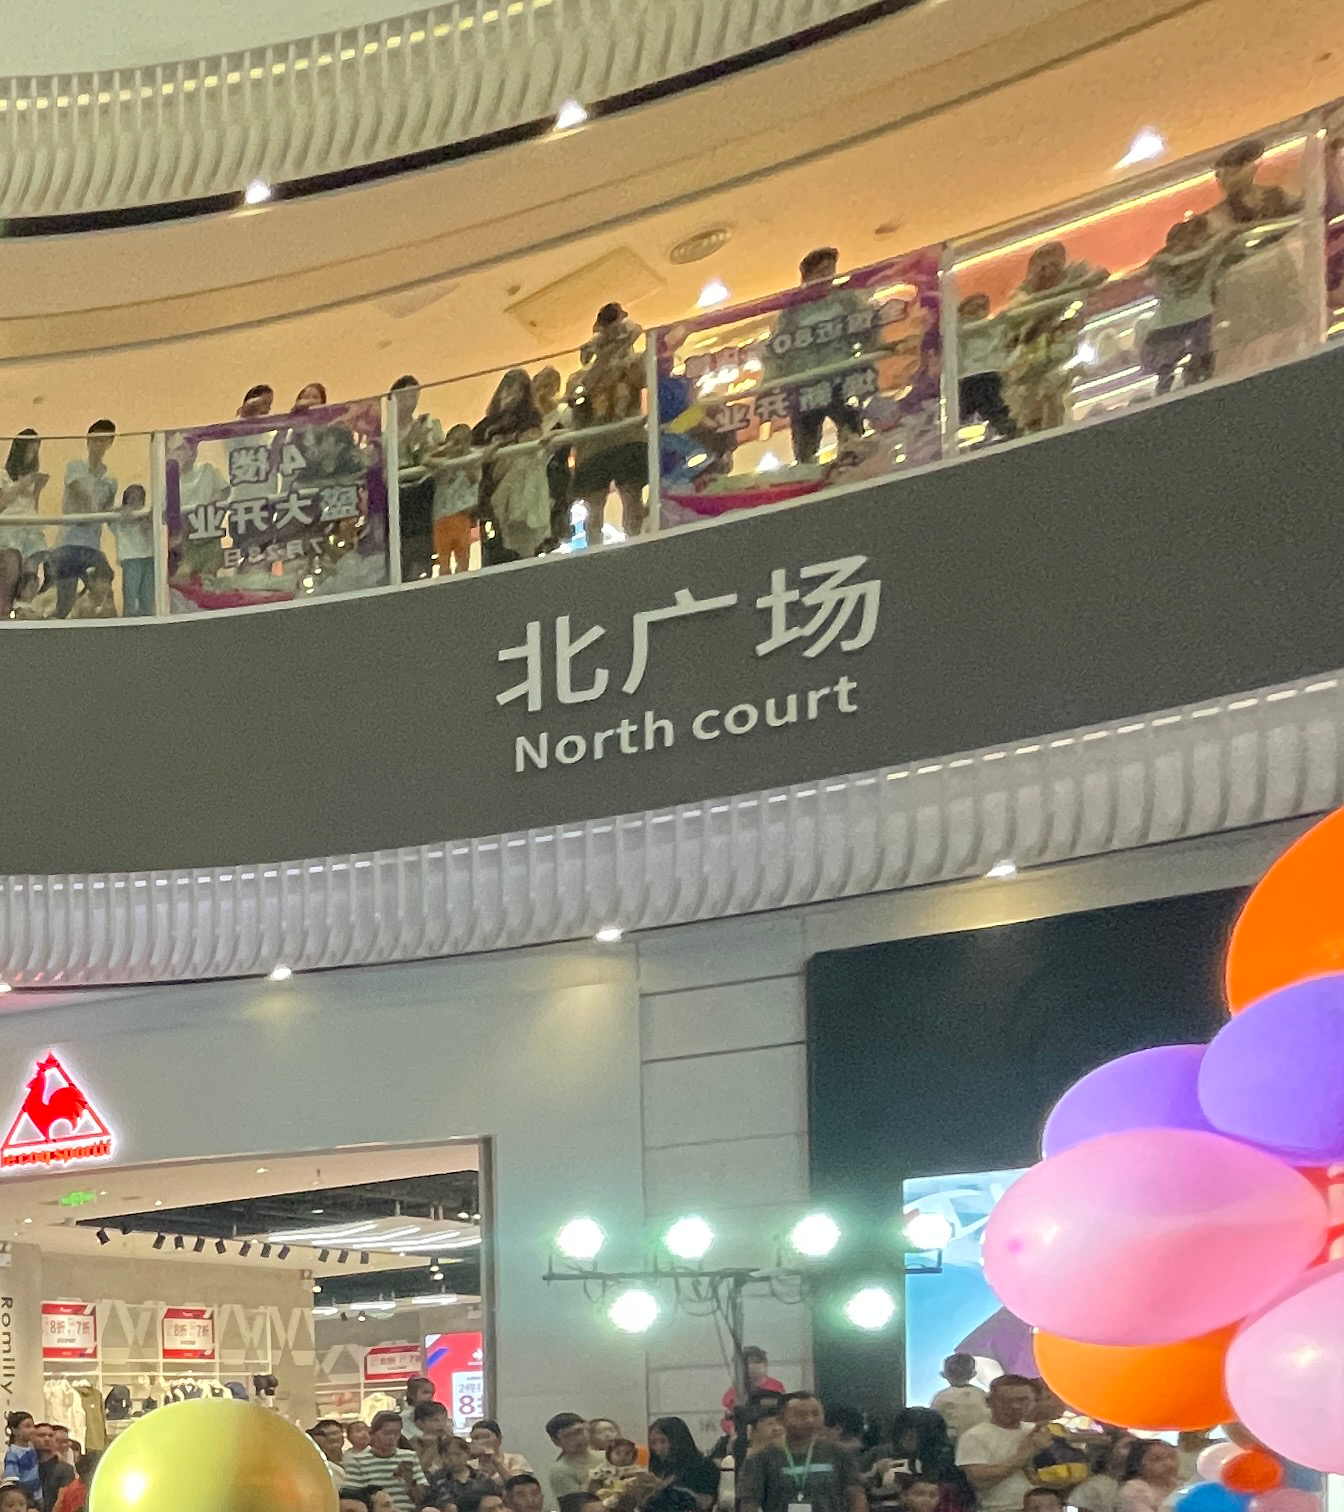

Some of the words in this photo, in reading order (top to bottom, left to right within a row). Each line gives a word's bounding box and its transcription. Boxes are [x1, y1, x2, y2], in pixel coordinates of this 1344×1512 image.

[496, 554, 881, 712] 北广场
[515, 710, 674, 772] North
[692, 676, 858, 740] court
